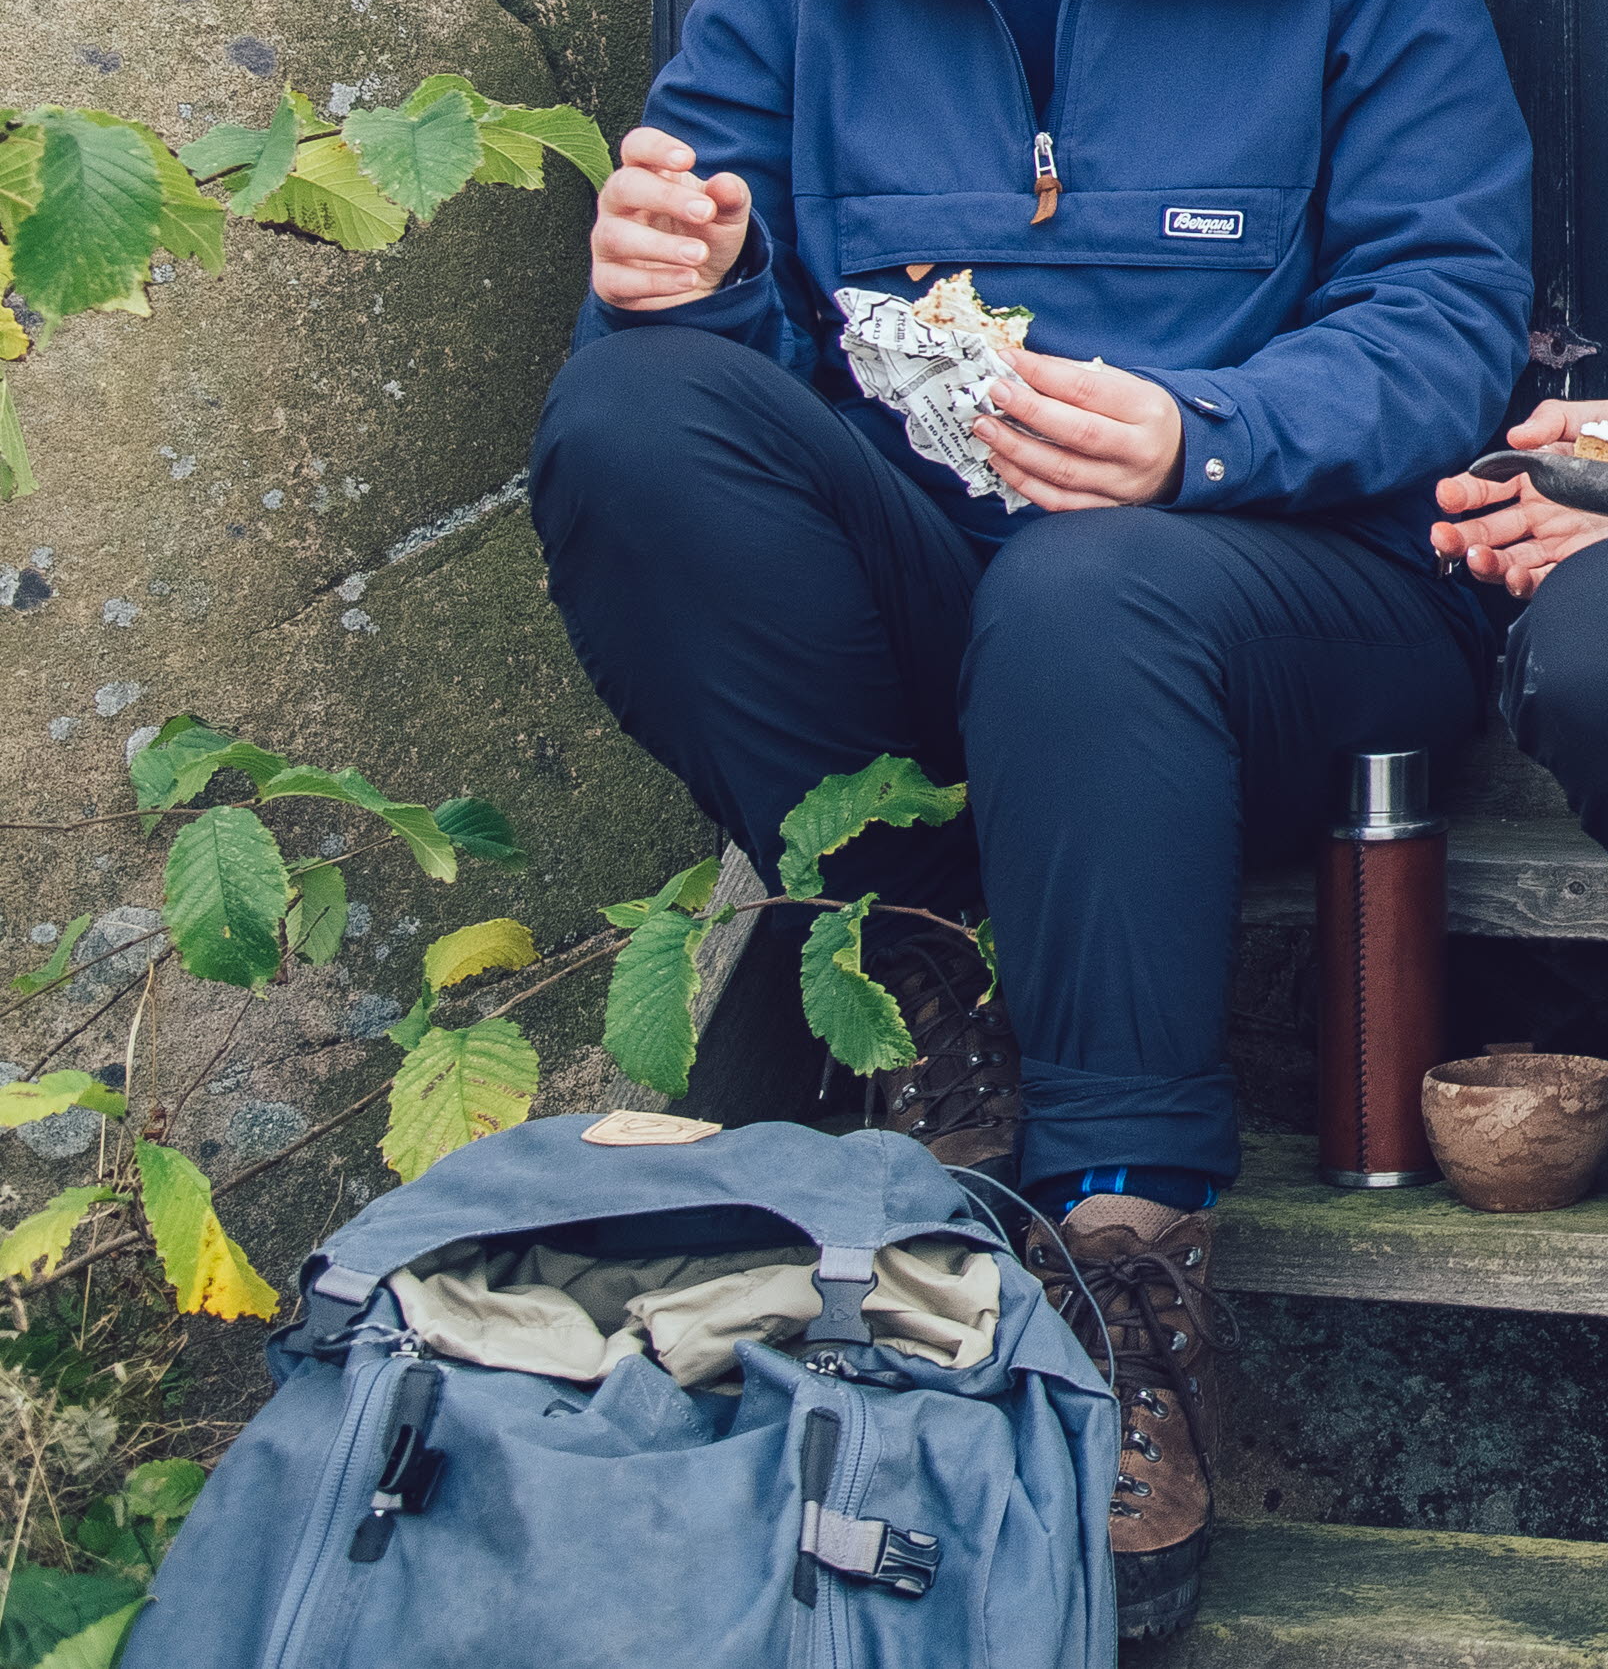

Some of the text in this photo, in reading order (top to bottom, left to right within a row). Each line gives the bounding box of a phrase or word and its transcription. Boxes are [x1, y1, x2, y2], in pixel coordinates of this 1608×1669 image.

[1173, 212, 1235, 234] Bergans
[923, 394, 949, 432] reserve,
[920, 412, 960, 464] is no better
